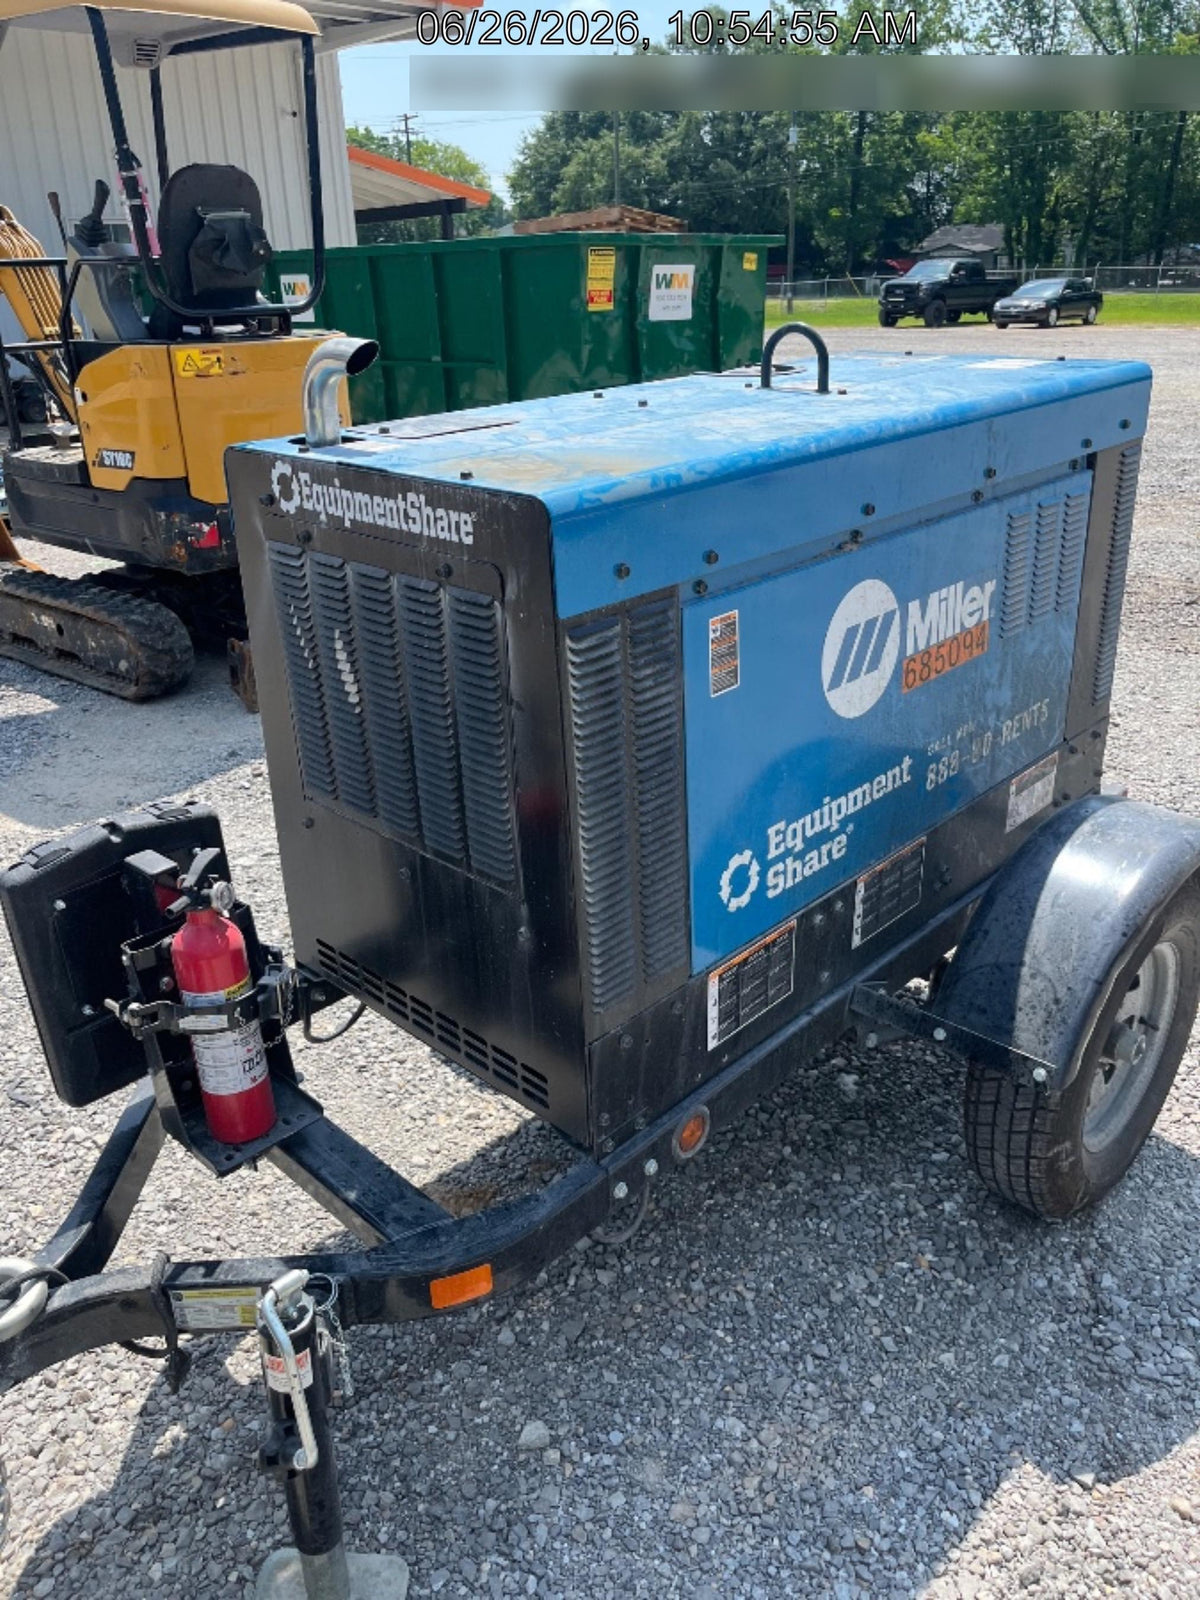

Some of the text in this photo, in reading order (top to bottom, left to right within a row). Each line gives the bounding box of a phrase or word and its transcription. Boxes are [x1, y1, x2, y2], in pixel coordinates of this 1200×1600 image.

[282, 282, 308, 296] WM
[655, 272, 689, 290] WM
[905, 579, 996, 657] Miller
[904, 622, 986, 689] 685094
[767, 754, 913, 861] Equipment
[766, 831, 848, 899] Share
